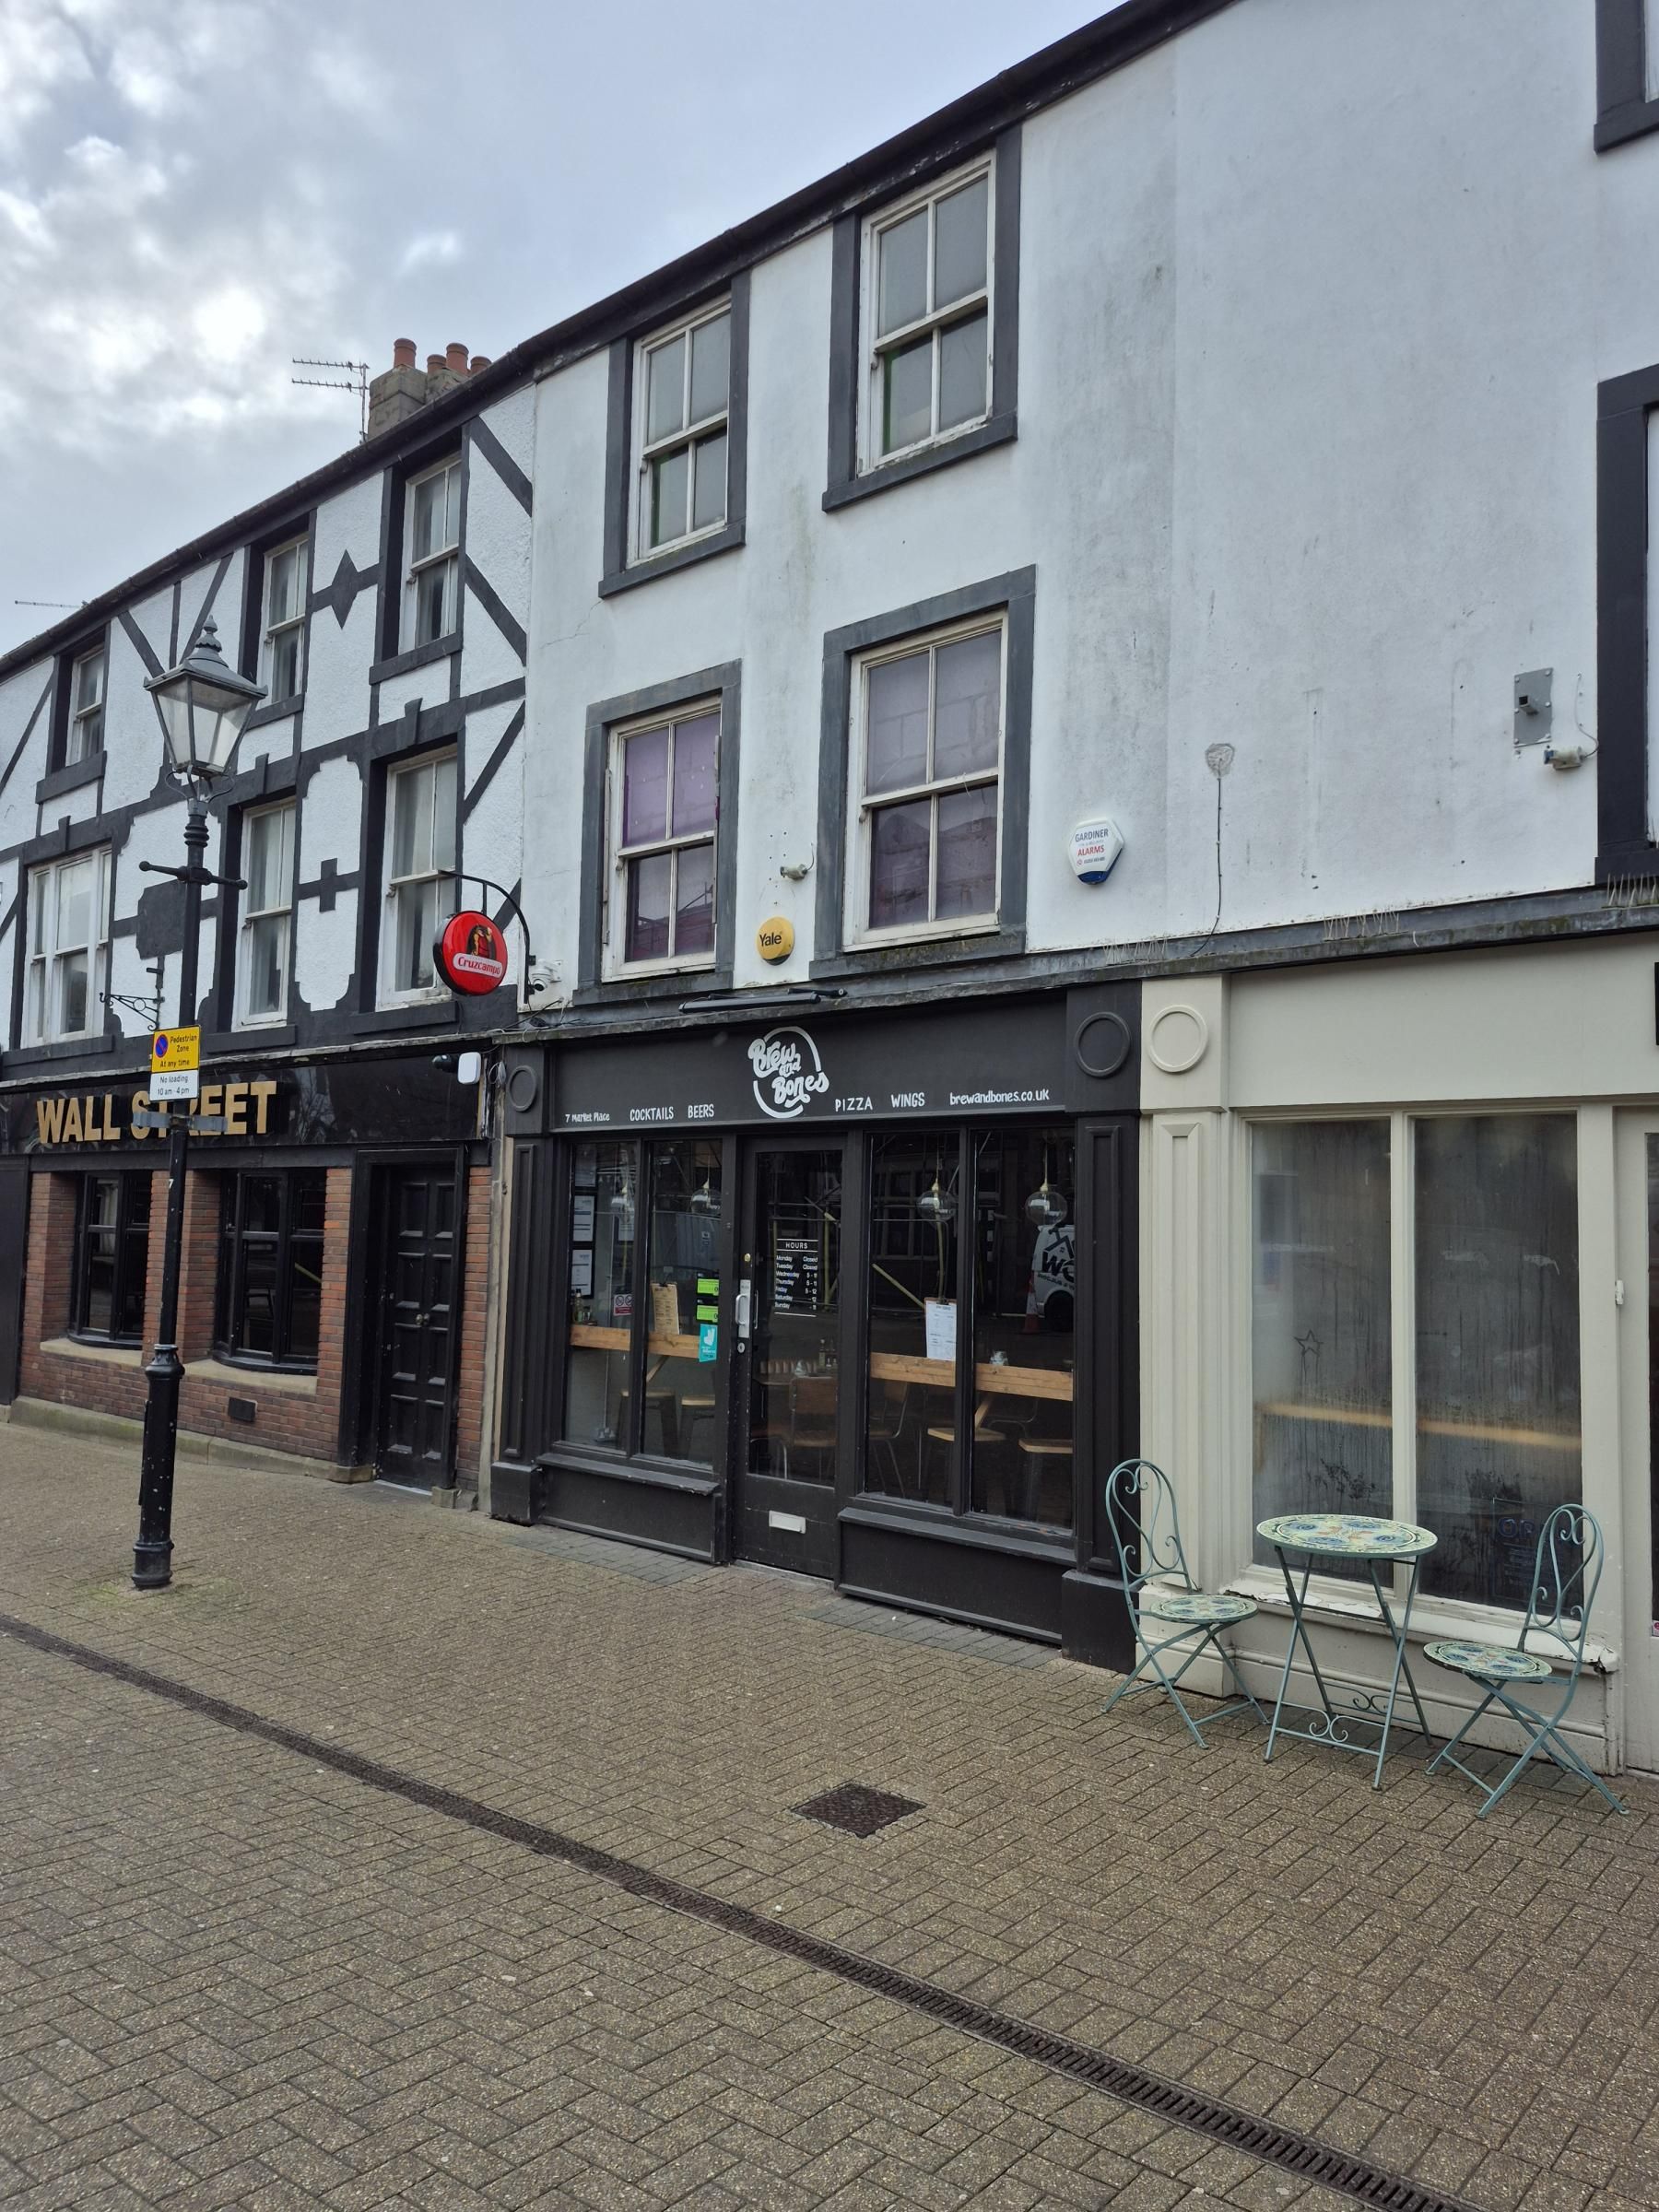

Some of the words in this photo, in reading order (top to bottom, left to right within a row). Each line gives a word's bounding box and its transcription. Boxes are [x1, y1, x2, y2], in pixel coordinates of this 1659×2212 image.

[1075, 828, 1109, 842] GARDINER
[1077, 844, 1105, 856] ALARMS
[759, 932, 782, 947] Yale
[458, 957, 501, 975] Cruzcampo
[170, 1033, 197, 1044] Pedestrian
[747, 1038, 796, 1078] Brew
[778, 1053, 802, 1078] and
[169, 1075, 189, 1084] loading
[771, 1071, 830, 1109] Bones
[949, 1088, 1050, 1106] brewandbones.co.uk
[834, 1096, 873, 1112] PIZZA
[890, 1091, 925, 1108] WINGS
[36, 1093, 122, 1144] WALL
[131, 1080, 276, 1140] SEET
[565, 1114, 569, 1123] 7
[593, 1112, 610, 1123] Place
[629, 1106, 675, 1122] COCKTAILS
[688, 1103, 714, 1119] BEERS
[775, 1270, 800, 1279] Wednesday
